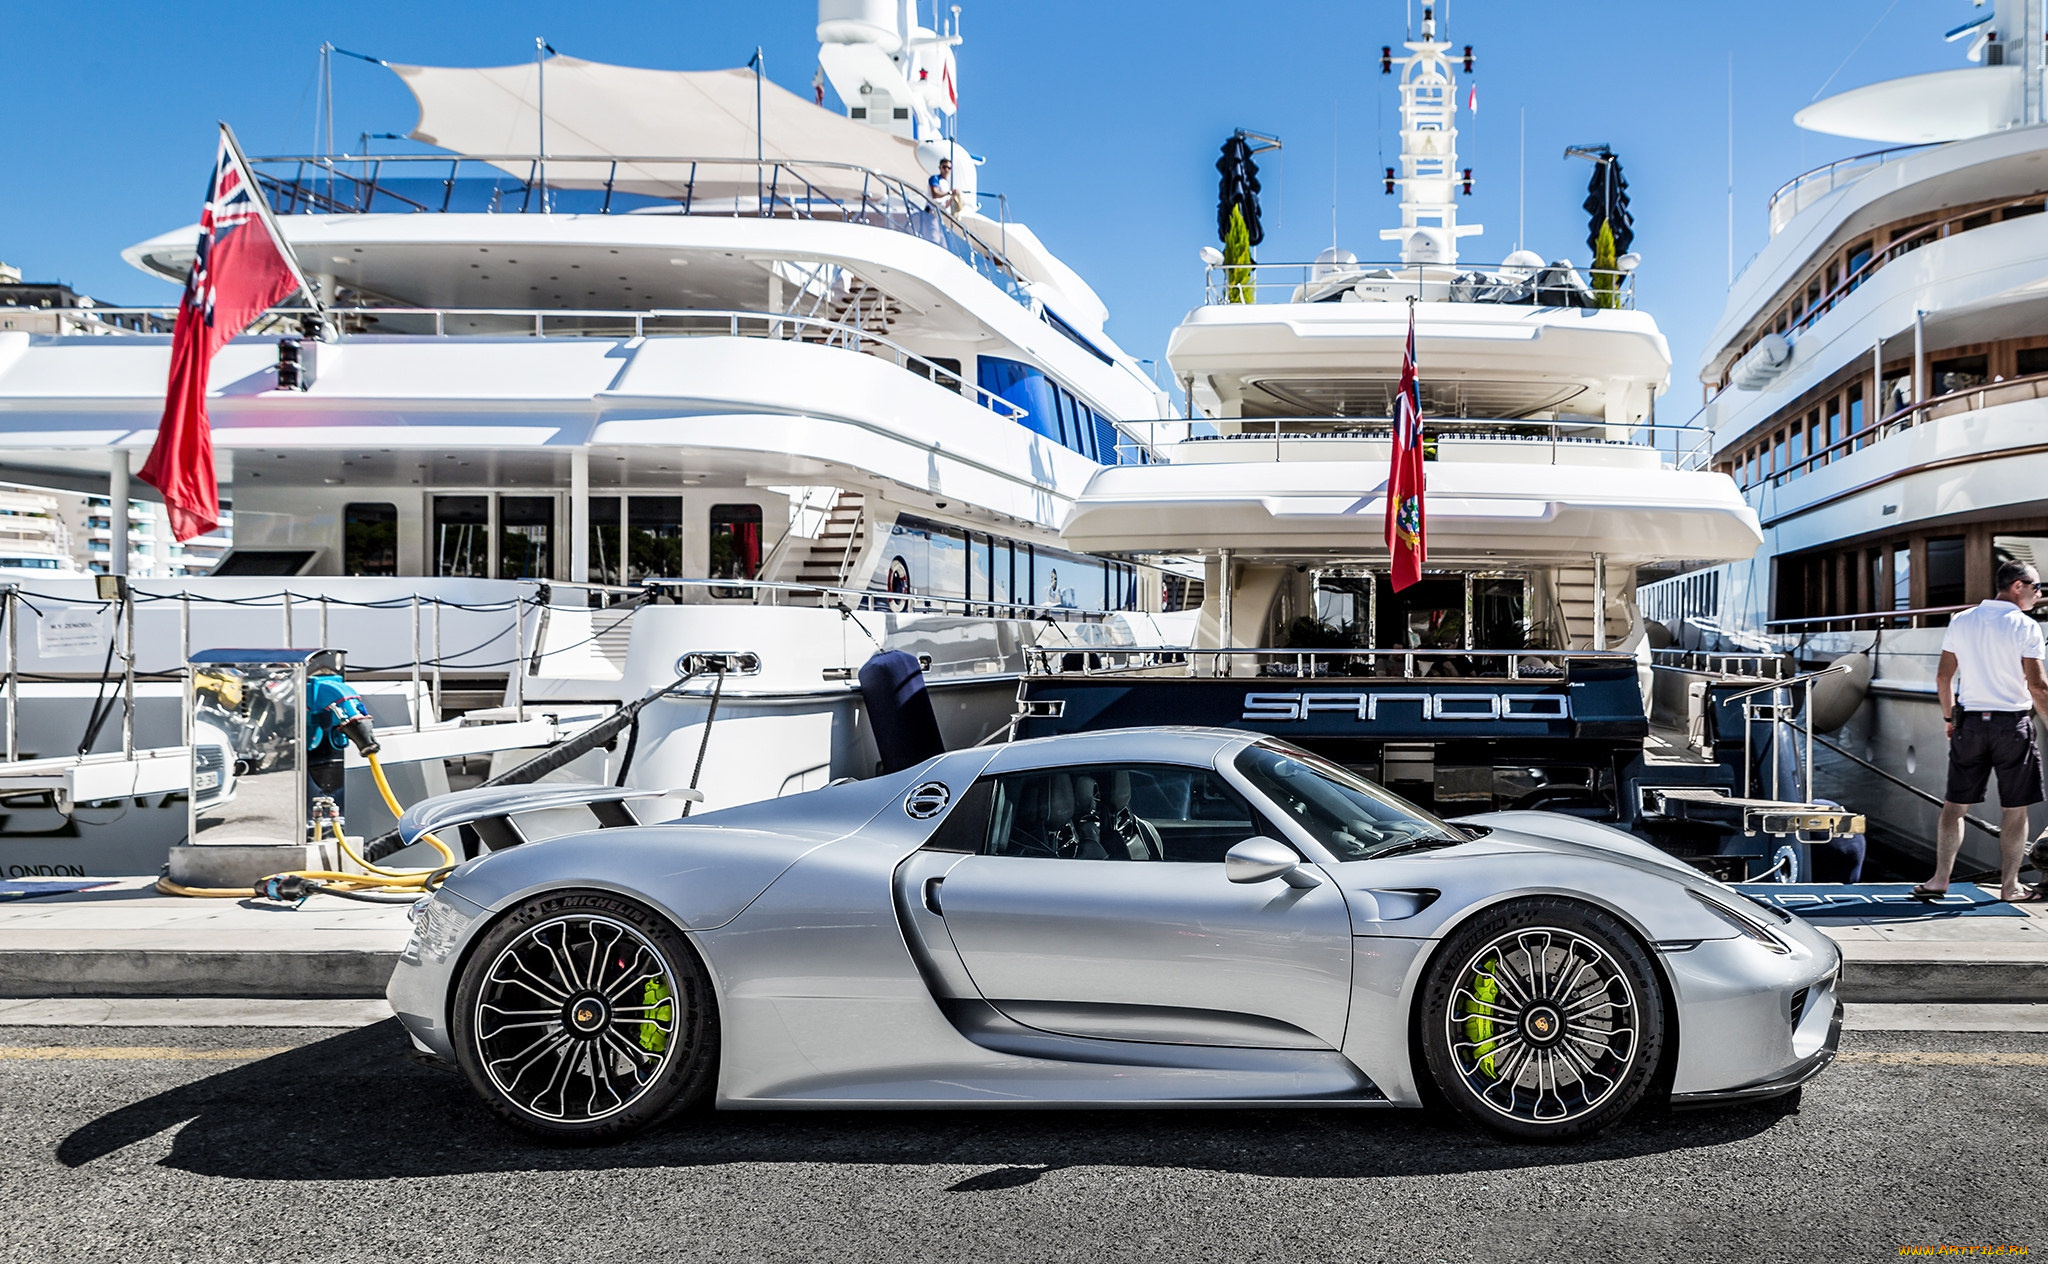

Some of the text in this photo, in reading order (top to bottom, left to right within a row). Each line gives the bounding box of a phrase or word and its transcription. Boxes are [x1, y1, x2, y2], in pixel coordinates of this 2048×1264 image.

[0, 864, 86, 878] LONDON
[562, 896, 645, 921] MICHELIN
[1448, 917, 1506, 970] MICHELIN
[1581, 1083, 1637, 1130] MICHELIN
